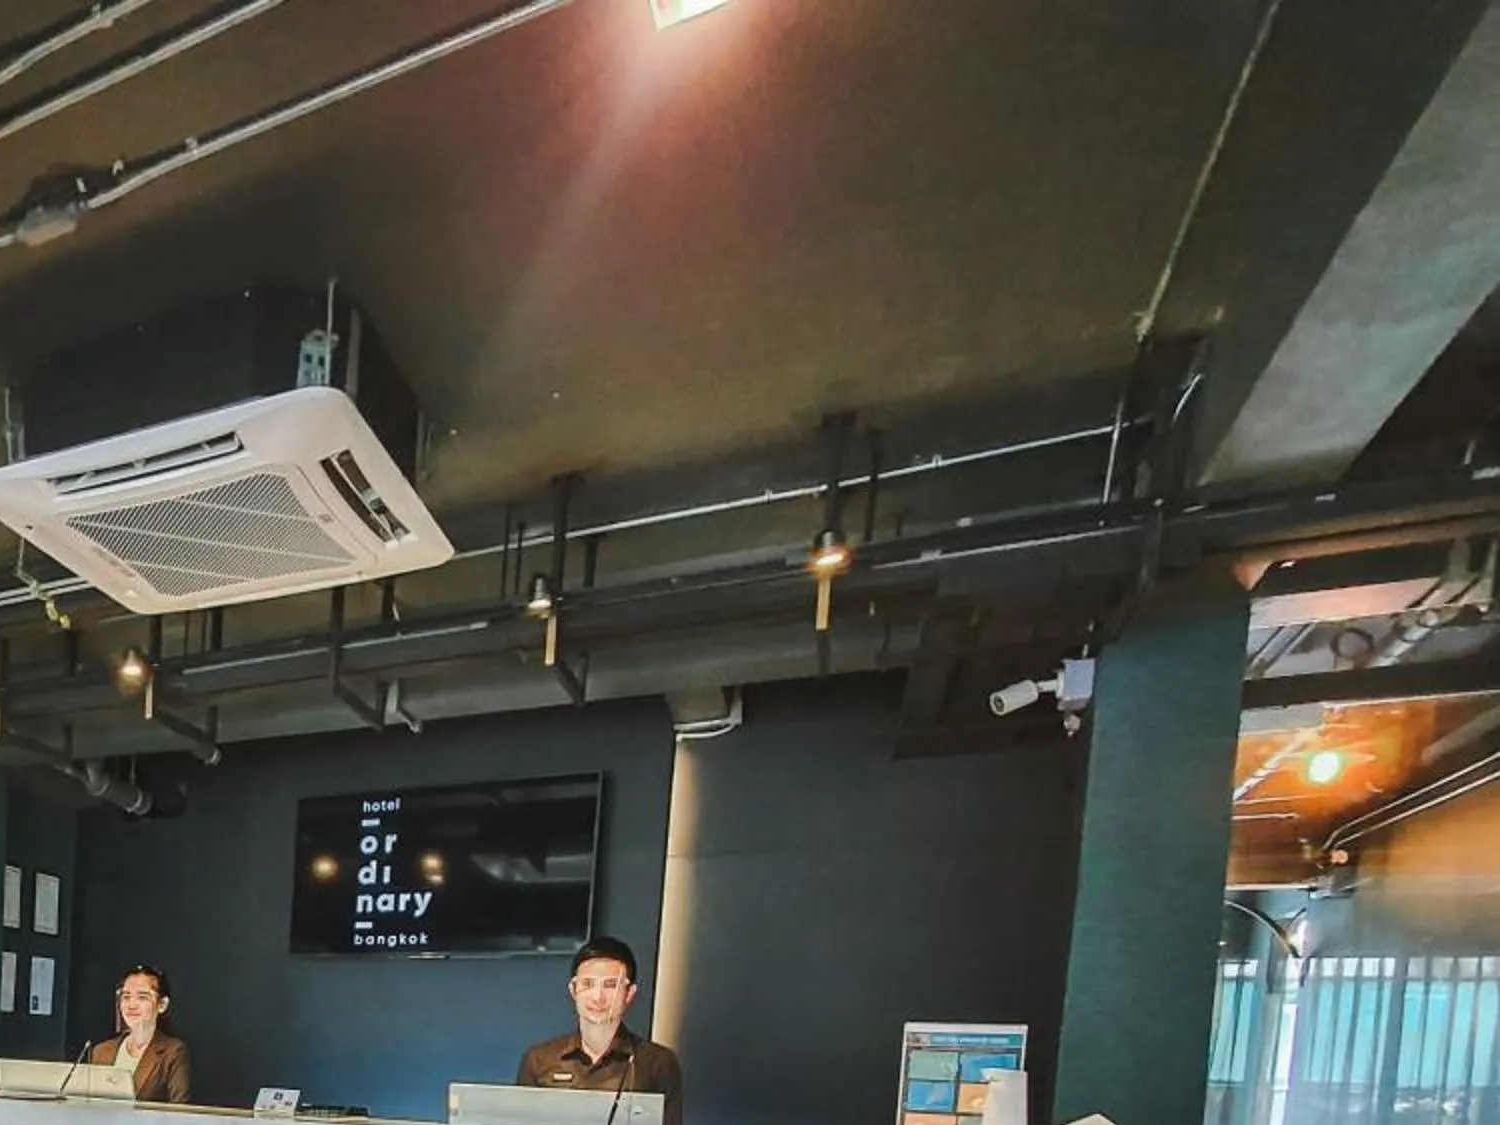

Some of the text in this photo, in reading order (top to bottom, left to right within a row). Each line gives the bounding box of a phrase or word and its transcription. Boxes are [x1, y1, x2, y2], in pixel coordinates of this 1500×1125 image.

[363, 798, 401, 812] hotel
[360, 834, 398, 854] or
[356, 892, 433, 917] nary
[354, 932, 428, 947] bangkok
